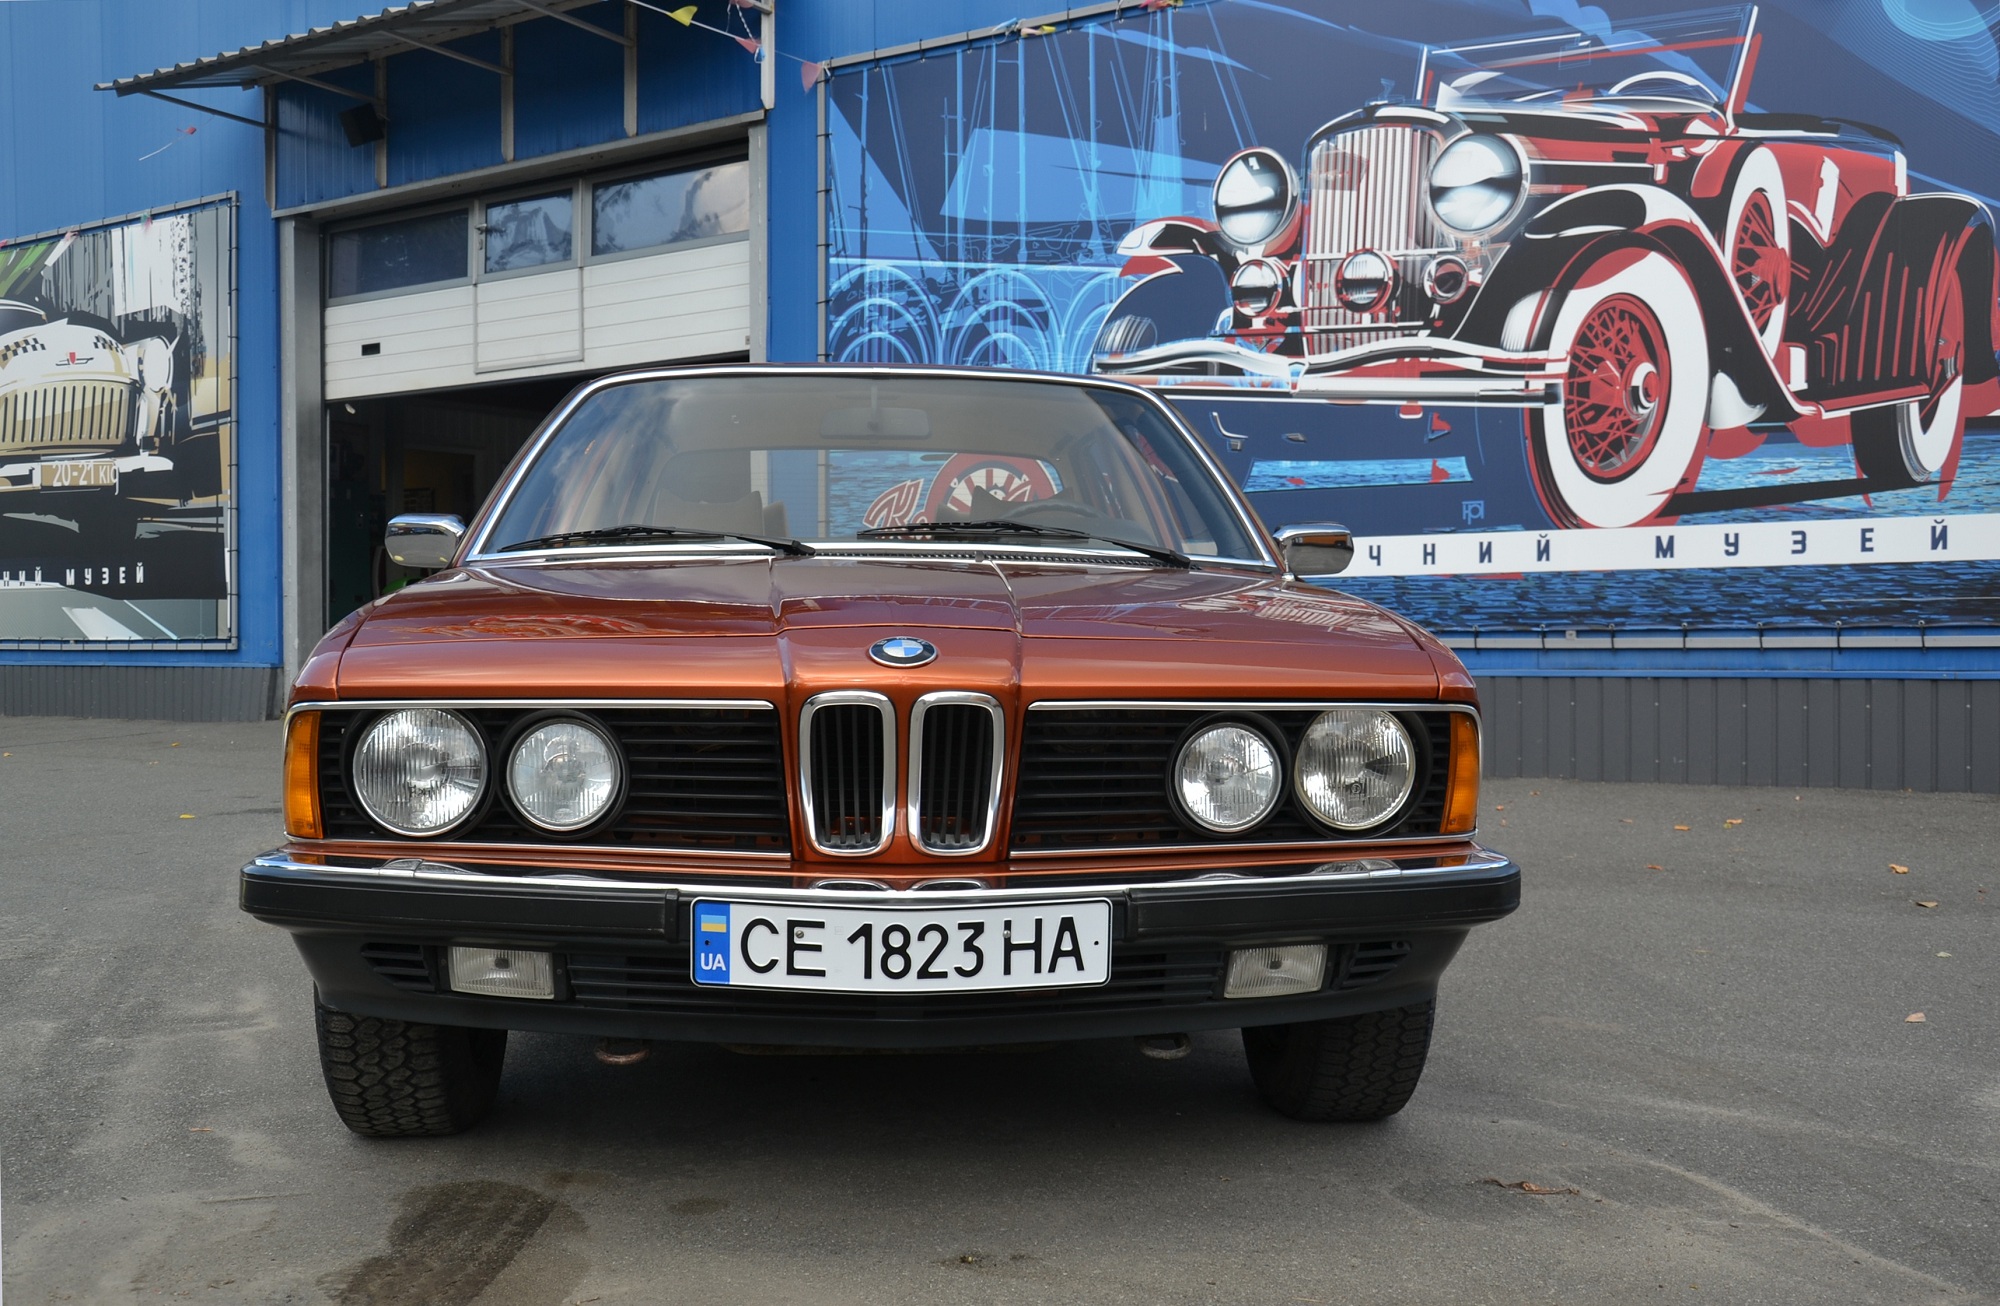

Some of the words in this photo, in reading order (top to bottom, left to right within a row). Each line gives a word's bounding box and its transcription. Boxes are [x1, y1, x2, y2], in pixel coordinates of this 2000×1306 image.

[1655, 519, 1948, 559] МУЗЕЙ
[66, 561, 144, 586] МУЗЕЙ
[700, 952, 727, 971] UA
[740, 917, 826, 977] CE
[846, 921, 985, 980] 1823
[1003, 916, 1085, 976] HA
